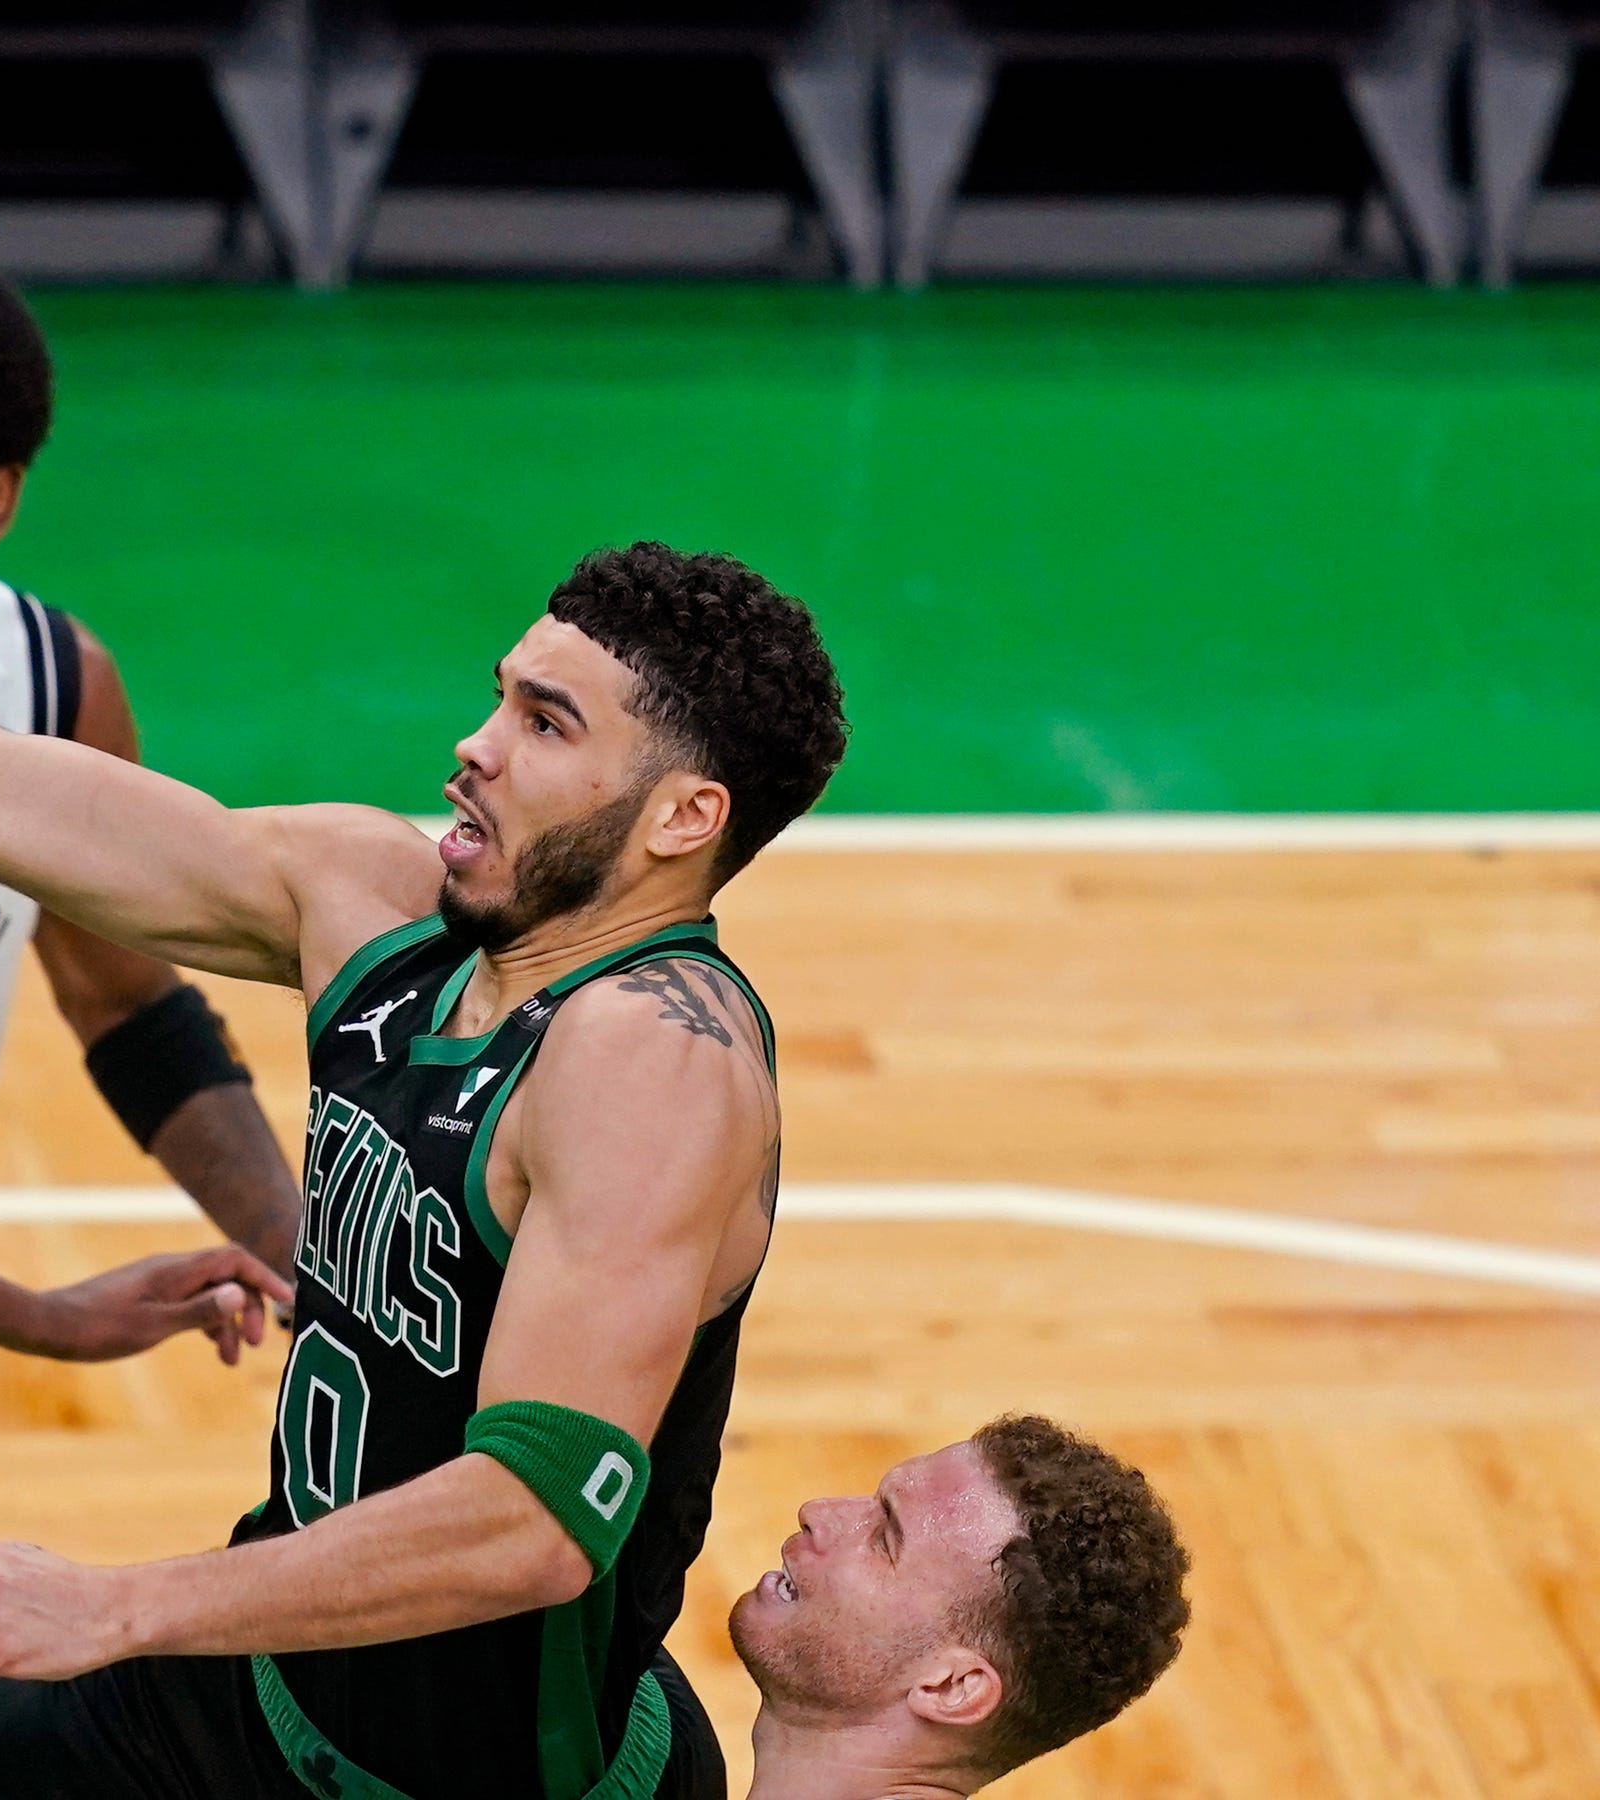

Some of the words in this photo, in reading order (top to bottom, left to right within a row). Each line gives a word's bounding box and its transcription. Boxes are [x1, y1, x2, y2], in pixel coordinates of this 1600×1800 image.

[426, 1112, 474, 1135] vistaprint
[279, 1319, 371, 1530] 0
[580, 1451, 634, 1521] 0
